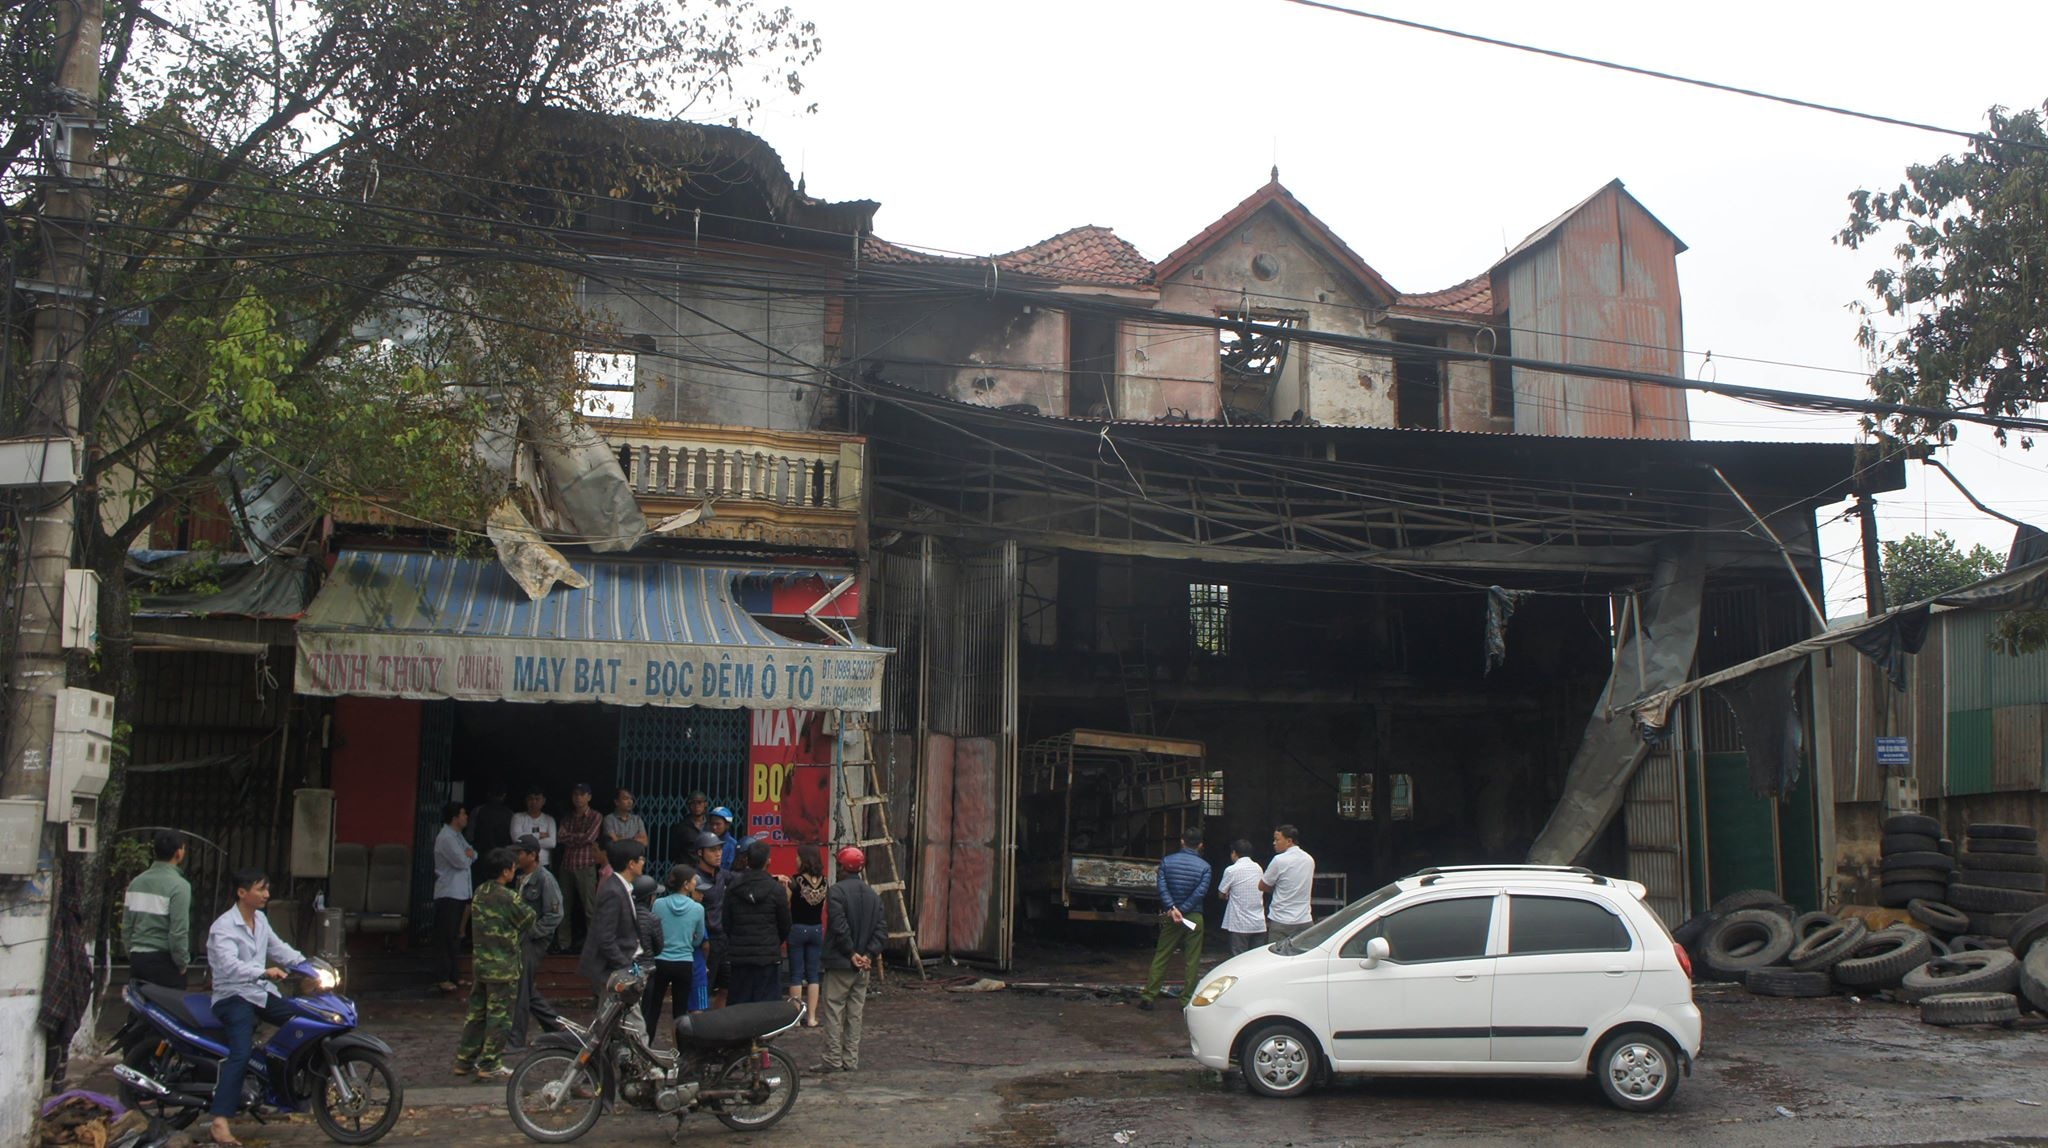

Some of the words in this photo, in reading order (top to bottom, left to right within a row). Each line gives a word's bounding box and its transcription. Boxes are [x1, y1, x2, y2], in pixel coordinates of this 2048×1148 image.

[377, 641, 446, 692] THỦY
[513, 655, 566, 693] MAY
[574, 658, 622, 701] BẠT
[645, 660, 694, 704] BỌC
[701, 653, 754, 705] ĐỆM
[761, 654, 776, 699] Ô
[785, 655, 814, 701] TÔ
[753, 762, 795, 811] BỌ
